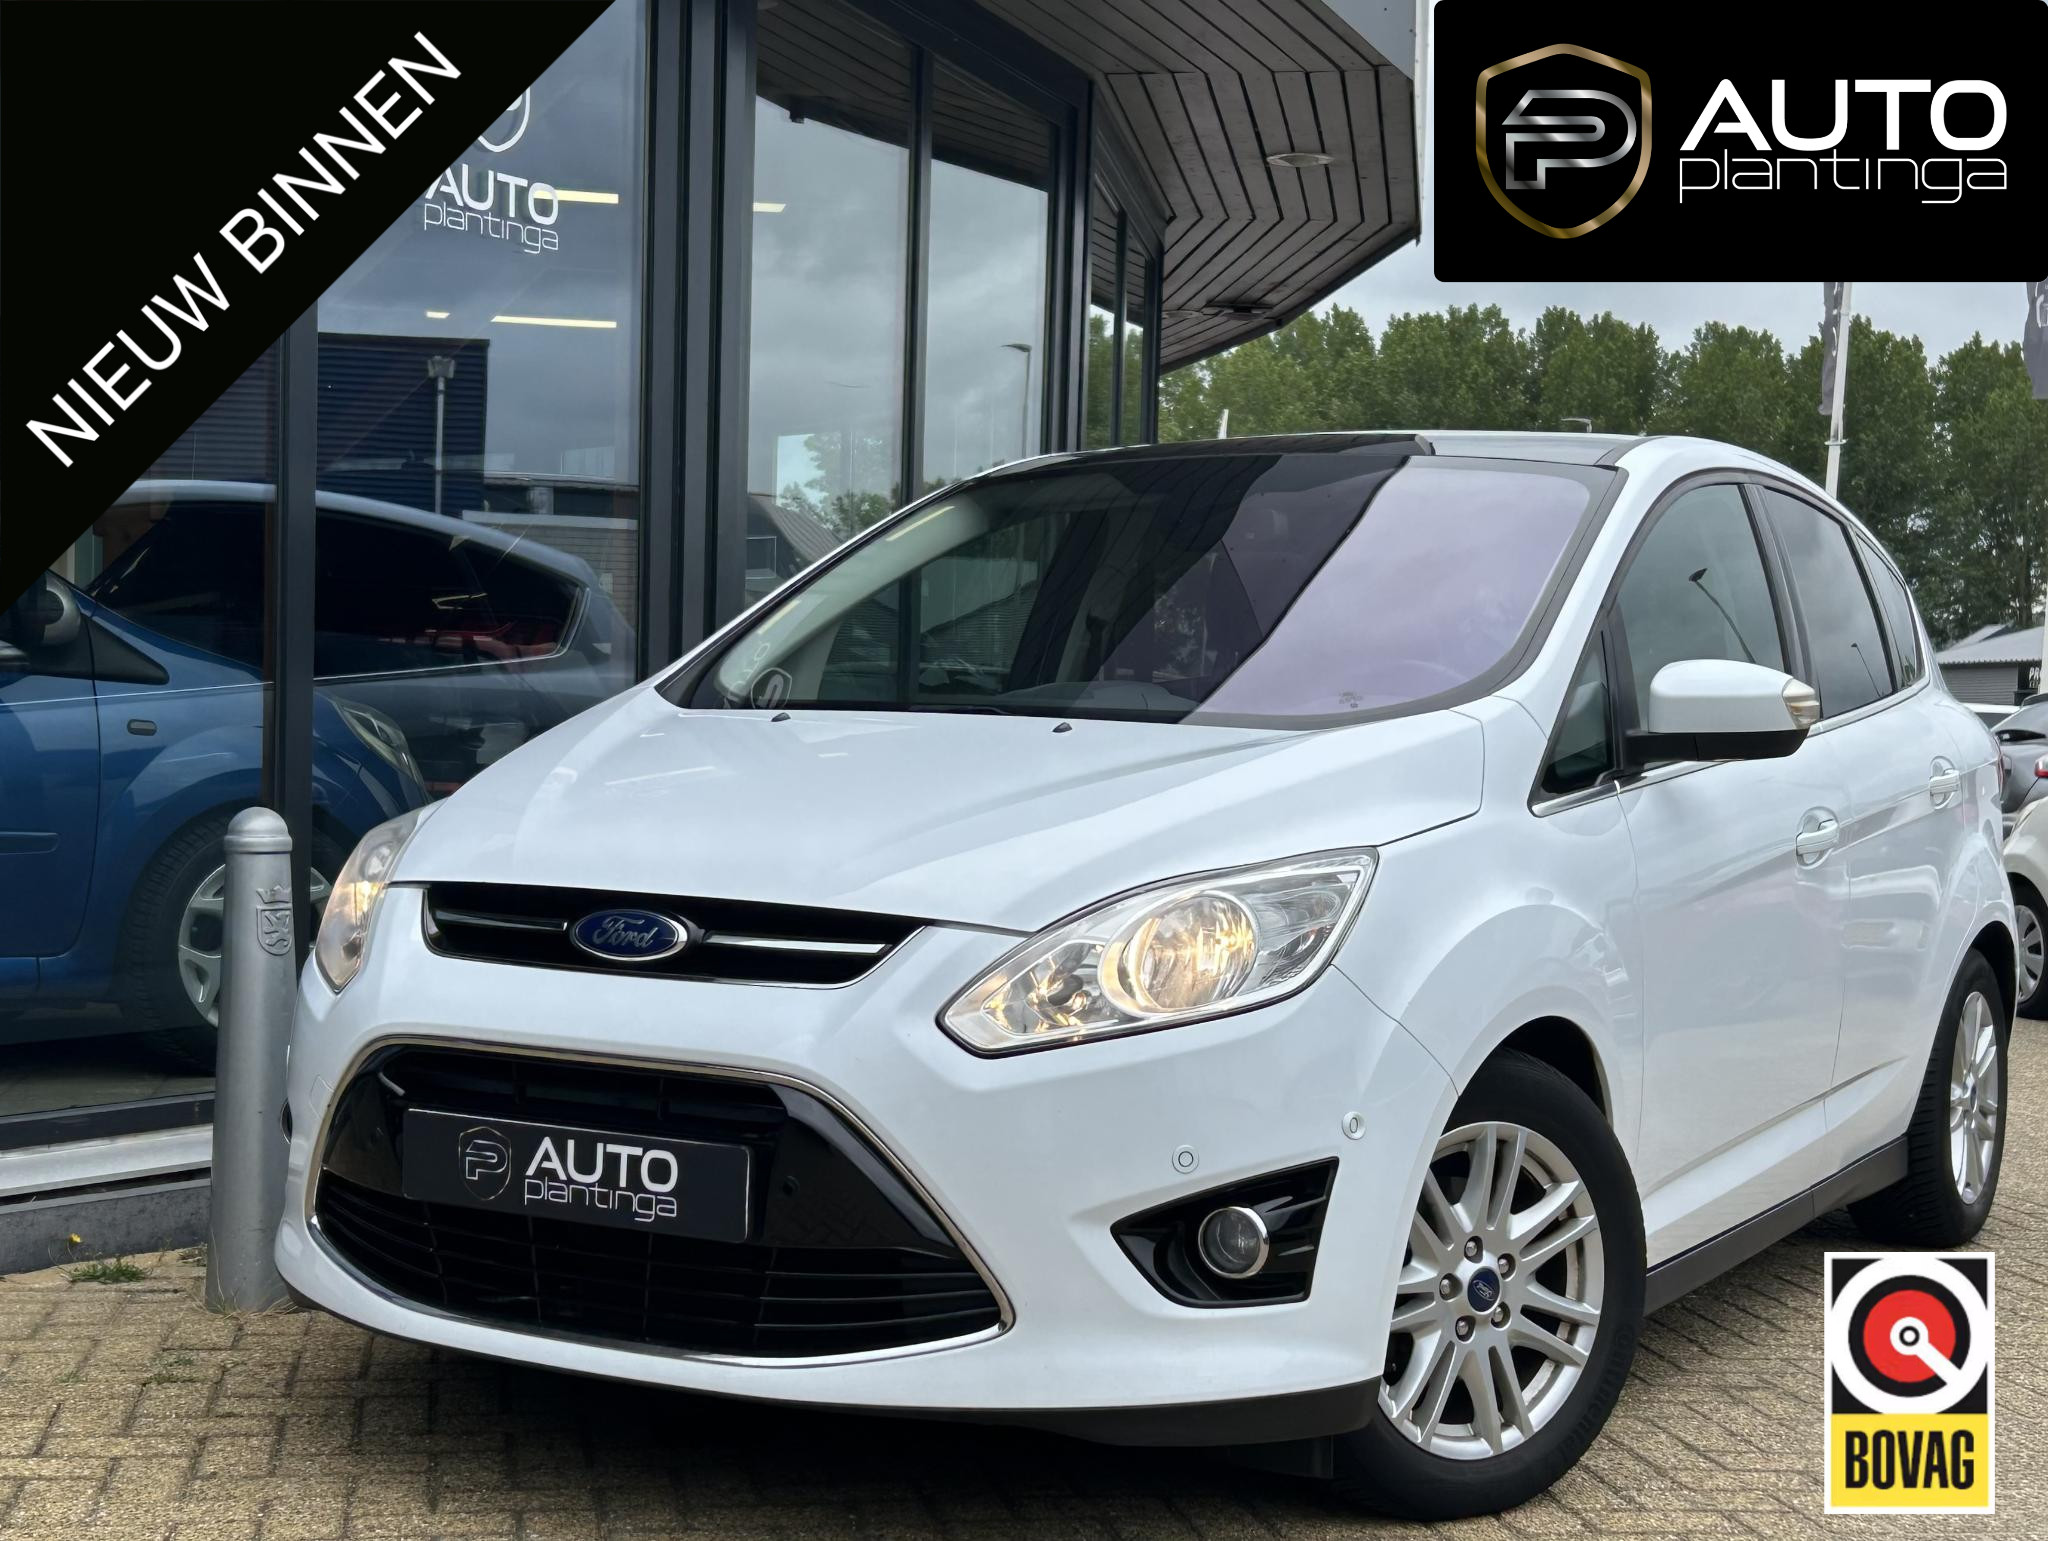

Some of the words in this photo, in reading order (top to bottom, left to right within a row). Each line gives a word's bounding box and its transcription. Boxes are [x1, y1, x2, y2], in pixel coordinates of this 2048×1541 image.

[425, 163, 559, 225] AUTO
[424, 201, 559, 254] plantinga
[592, 915, 659, 948] Ford
[525, 1136, 679, 1193] AUTO
[524, 1176, 678, 1222] plantinga
